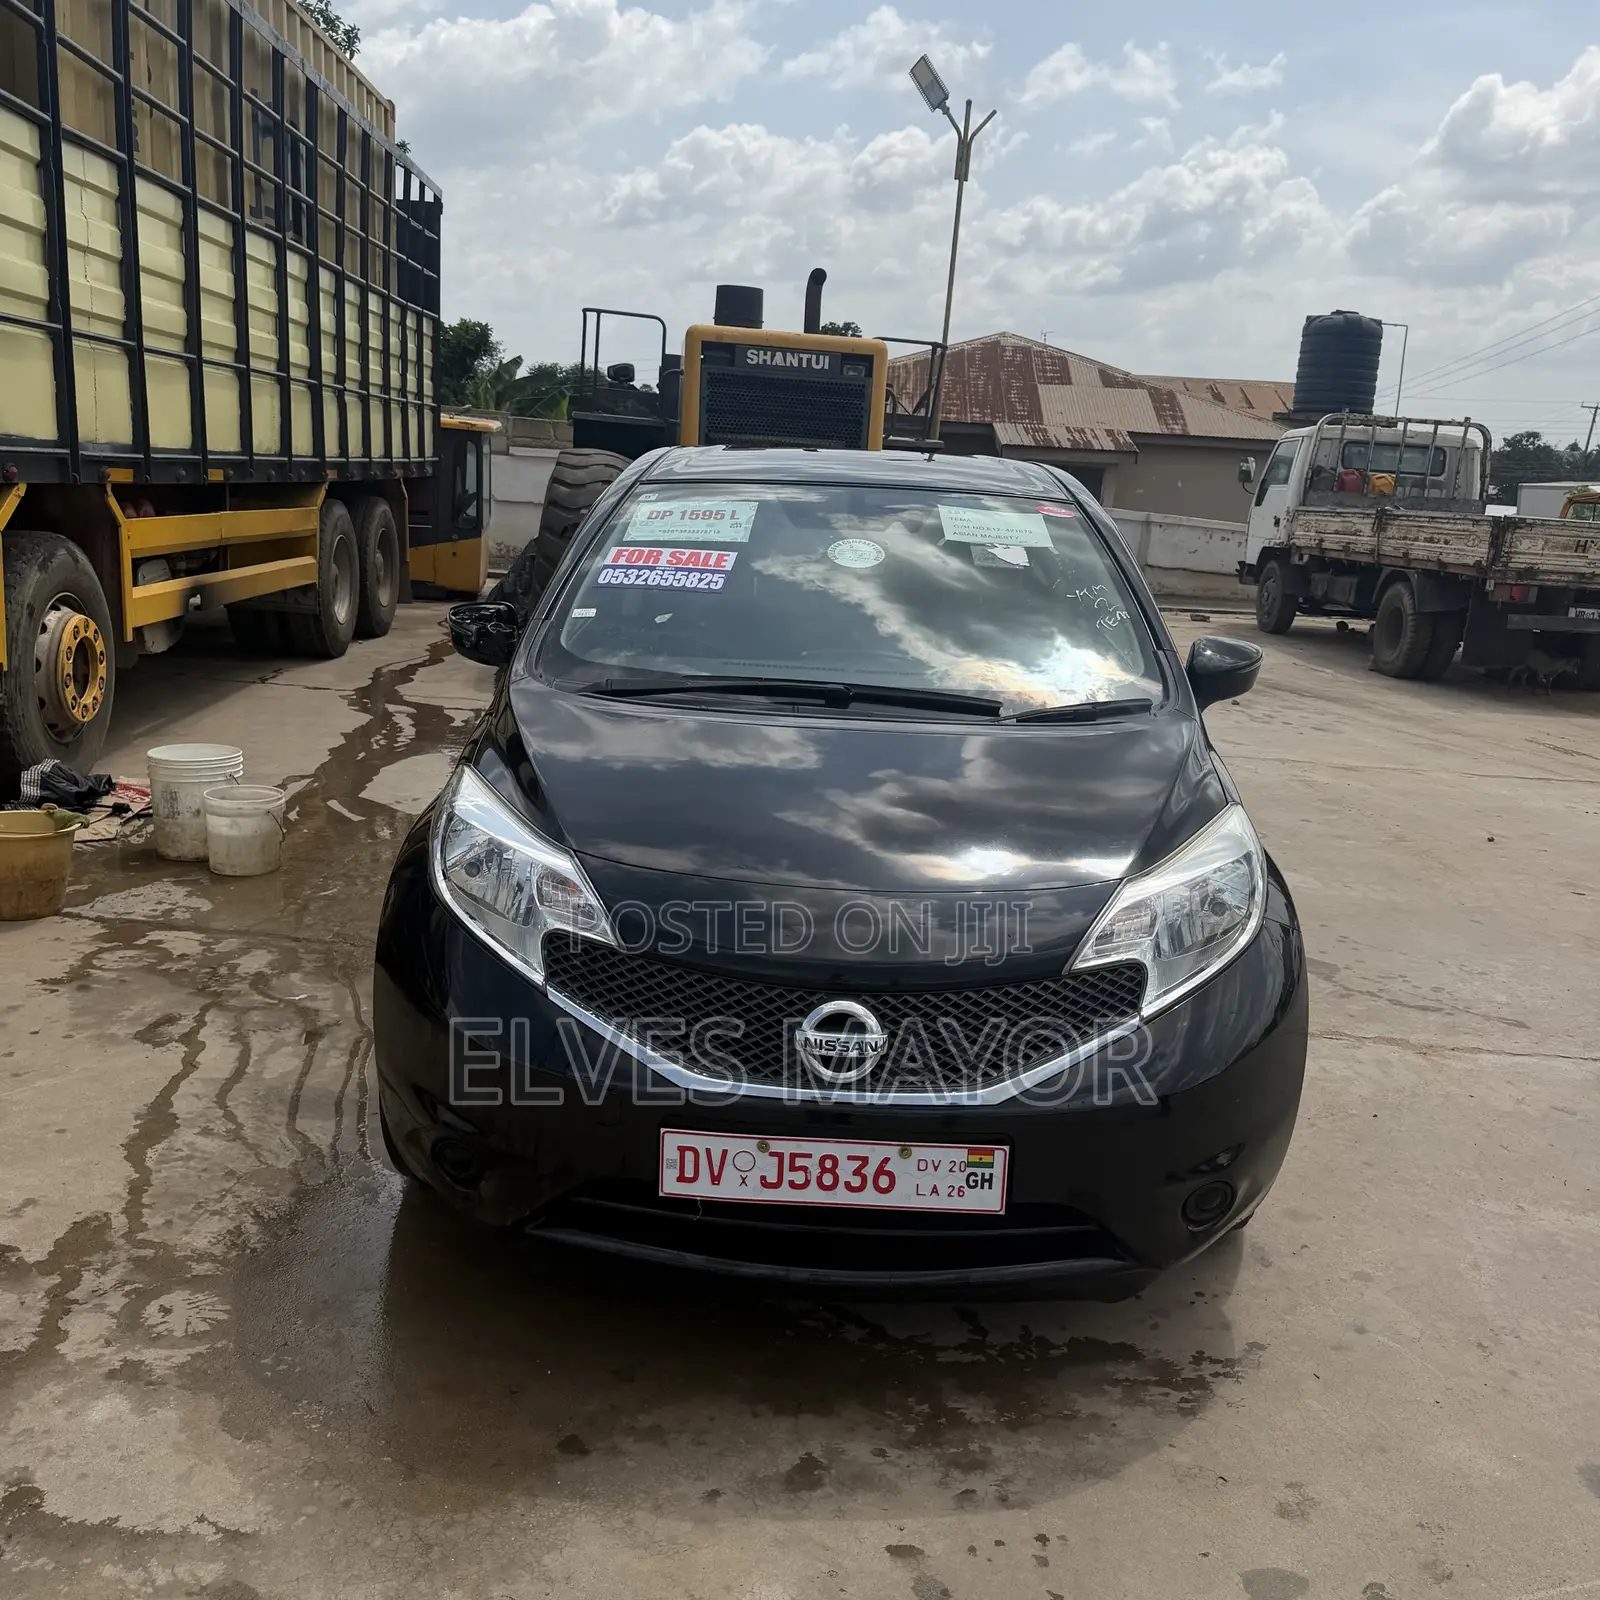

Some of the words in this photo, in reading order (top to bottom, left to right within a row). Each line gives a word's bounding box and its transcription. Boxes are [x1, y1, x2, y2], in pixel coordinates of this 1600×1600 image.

[746, 349, 829, 370] SHANTUI
[647, 510, 674, 520] DP
[680, 509, 727, 521] 1595
[729, 510, 740, 520] L
[611, 548, 663, 565] FOR
[666, 550, 730, 568] SALE
[597, 568, 726, 590] 0532655825
[803, 1036, 878, 1053] NISSAN
[676, 1145, 729, 1186] DV
[759, 1151, 897, 1194] J5836
[916, 1159, 942, 1173] DV
[948, 1160, 968, 1173] 20
[965, 1171, 994, 1190] GH
[916, 1183, 940, 1197] LA
[947, 1185, 966, 1198] 26
